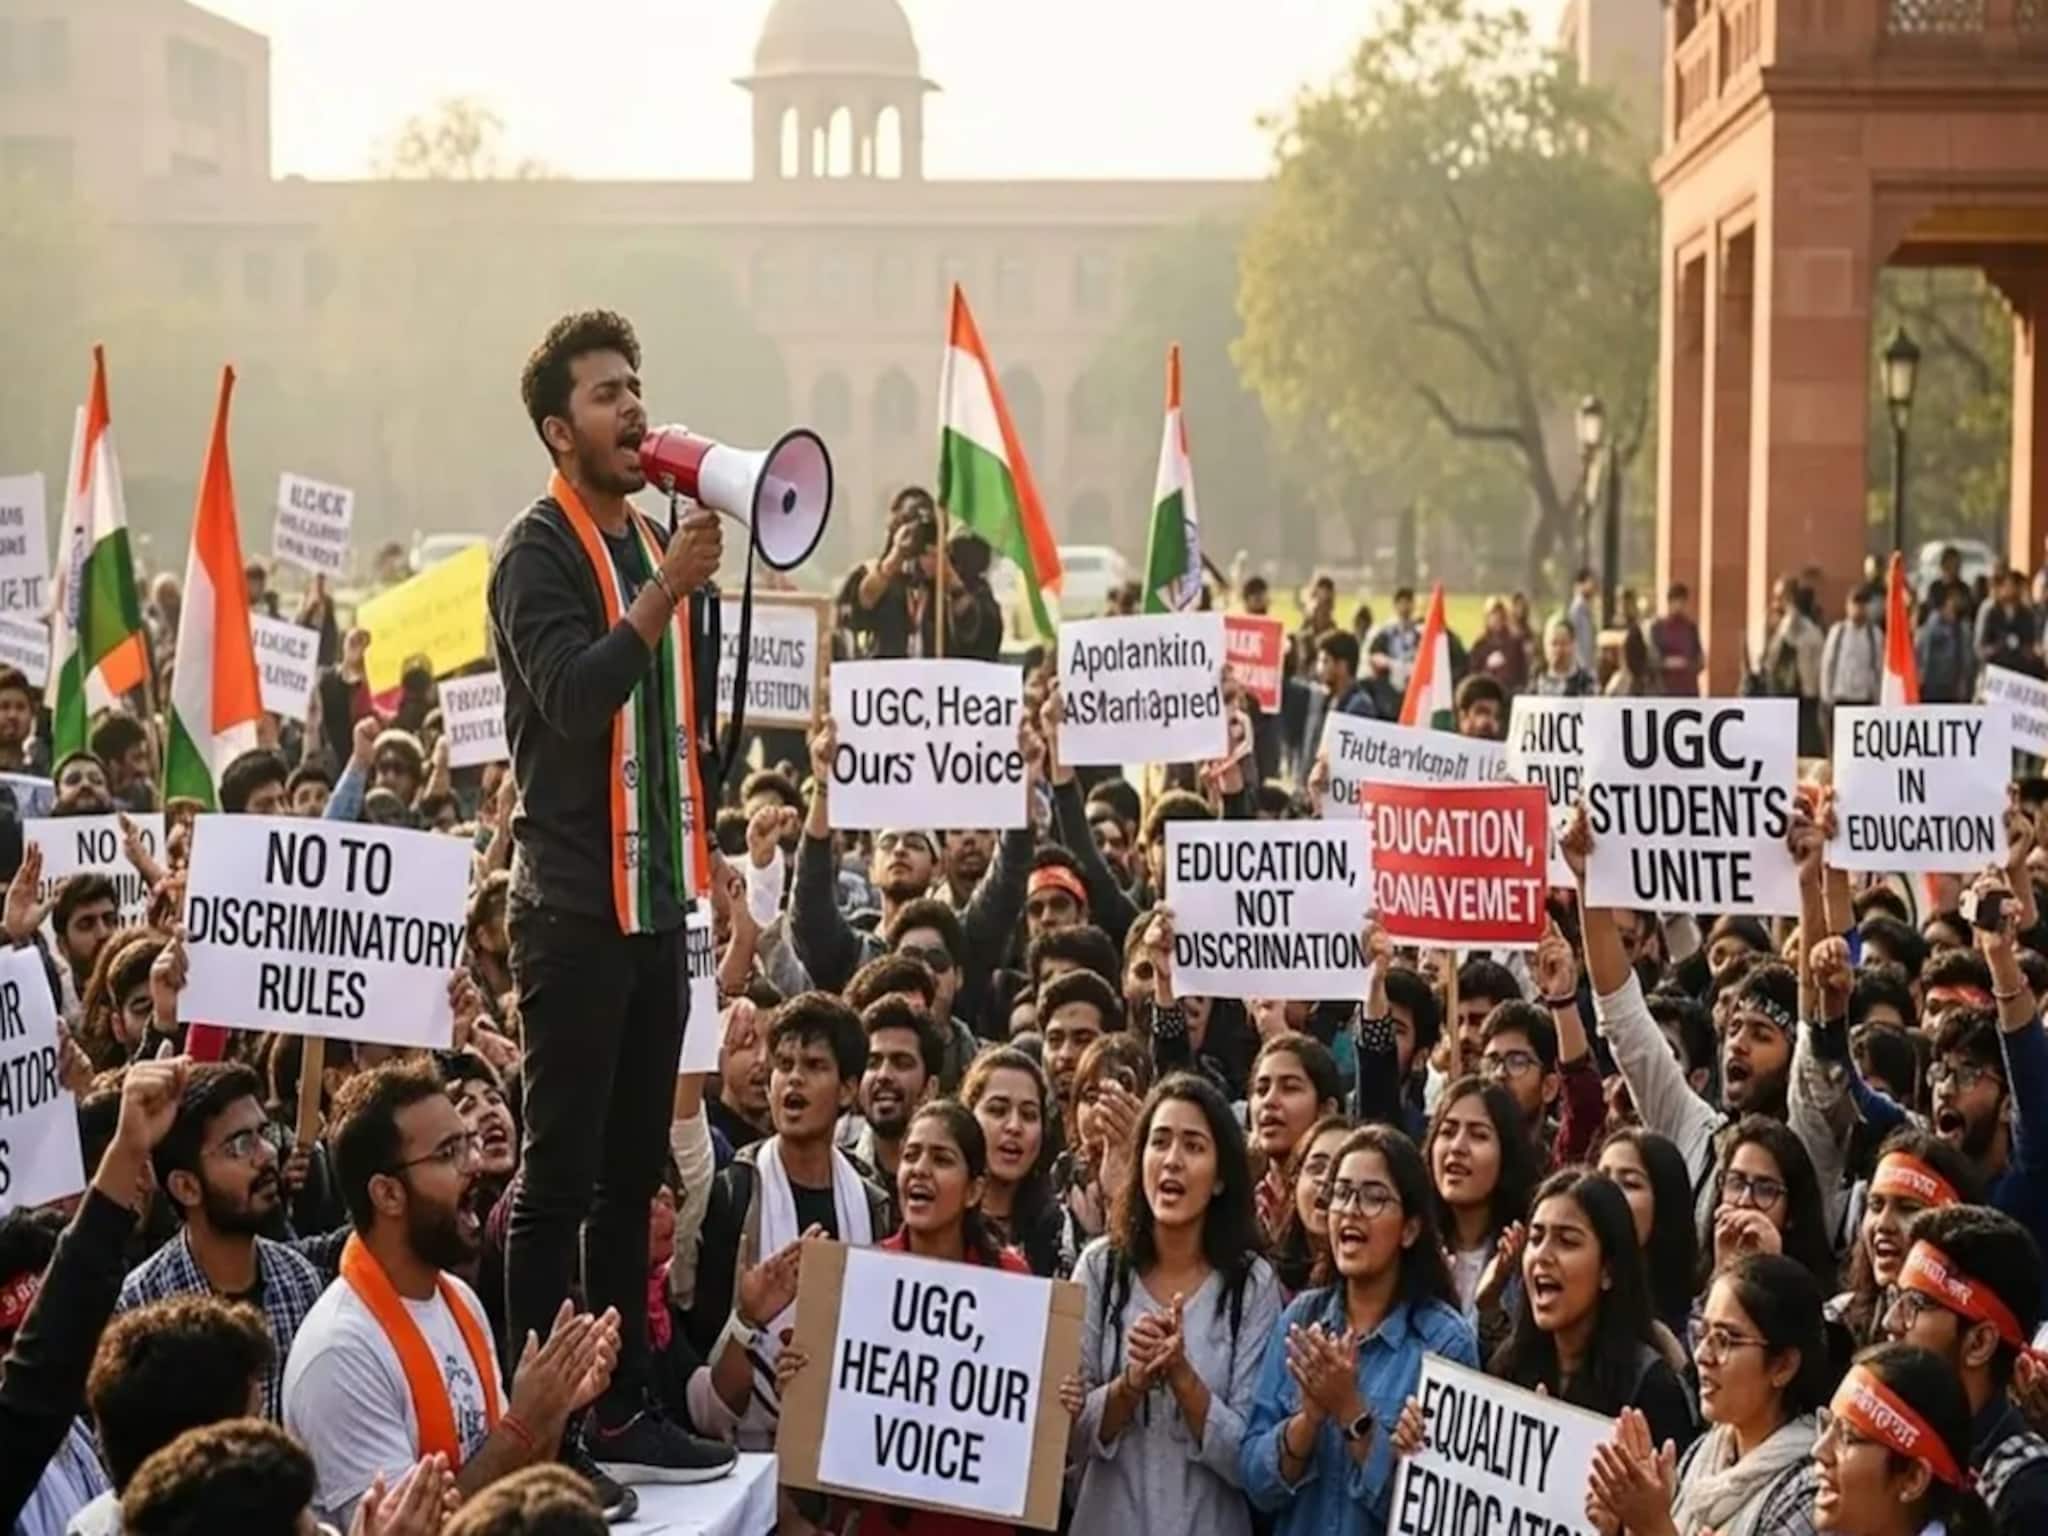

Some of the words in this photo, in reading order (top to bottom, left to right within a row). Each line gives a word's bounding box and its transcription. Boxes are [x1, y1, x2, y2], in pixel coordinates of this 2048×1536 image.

[851, 686, 932, 731] UGC,
[938, 684, 1019, 728] Hear
[926, 741, 1025, 787] Voice
[1621, 707, 1764, 783] UGC,
[1852, 718, 1983, 760] EQUALITY
[1589, 784, 1787, 838] STUDENTS
[1898, 767, 1926, 804] IN
[76, 828, 118, 865] NO
[1847, 814, 1996, 853] EDUCATION
[265, 830, 328, 888] NO
[340, 838, 393, 896] TO
[1177, 840, 1356, 888] EDUCATION,
[1631, 847, 1755, 905] UNITE
[187, 896, 465, 970] DISCRIMINATORY
[1235, 888, 1296, 929] NOT
[258, 962, 368, 1020] RULES
[891, 1278, 985, 1354] UGC,
[839, 1338, 940, 1408] HEAR
[950, 1359, 1031, 1424] OUR
[874, 1412, 985, 1485] VOICE
[1421, 1377, 1561, 1494] EQUALITY
